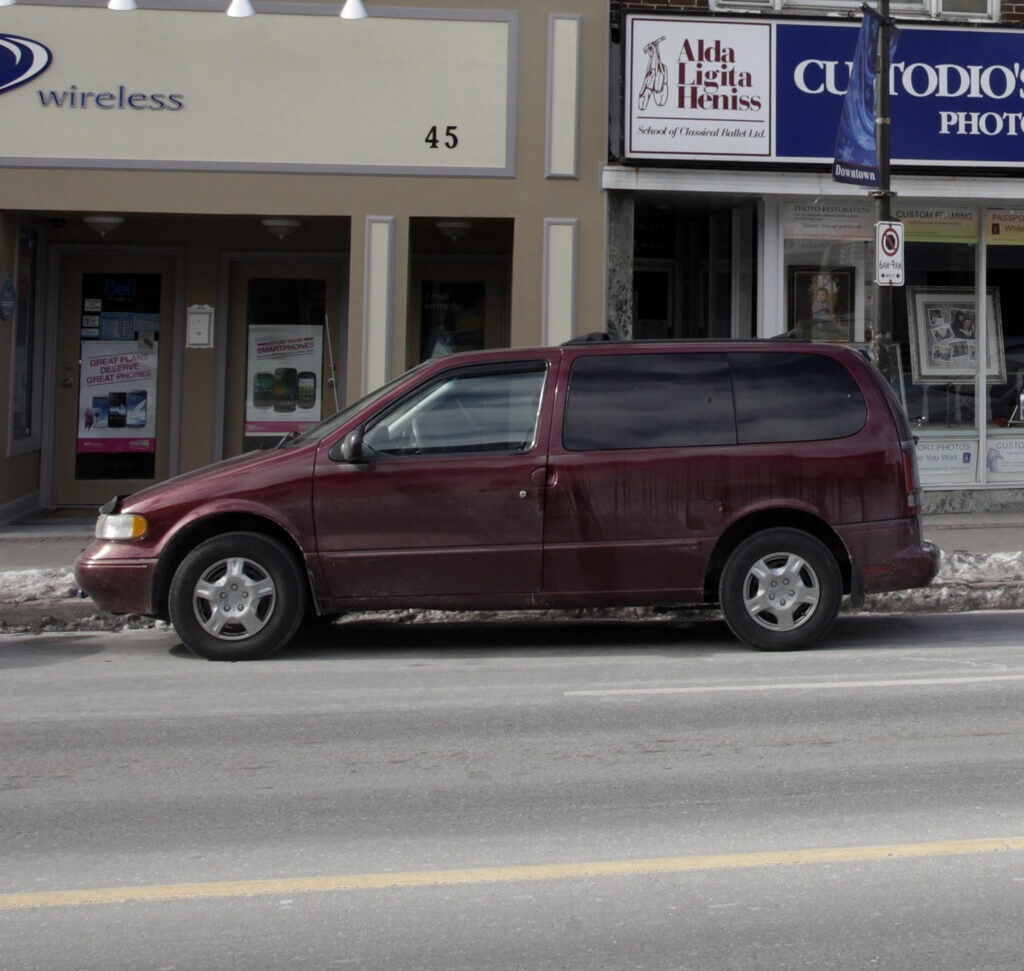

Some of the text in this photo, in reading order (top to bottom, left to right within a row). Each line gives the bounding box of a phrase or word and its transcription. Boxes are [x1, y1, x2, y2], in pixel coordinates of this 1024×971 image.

[677, 38, 736, 63] Alda
[676, 62, 753, 94] Ligita
[37, 84, 185, 111] wireless
[676, 86, 762, 111] Heniss
[424, 125, 459, 149] 45
[637, 125, 767, 139] School of Classical Ballet Ltd.
[835, 164, 876, 181] Downtown
[896, 210, 933, 219] CUSTOM
[1004, 225, 1024, 233] While
[104, 278, 137, 297] Bell
[256, 342, 315, 354] SMARTPHONES
[89, 356, 119, 367] GREAT
[100, 363, 140, 374] DESERVE
[86, 370, 152, 384] GREAT PHONES
[936, 443, 970, 451] PHOTOS
